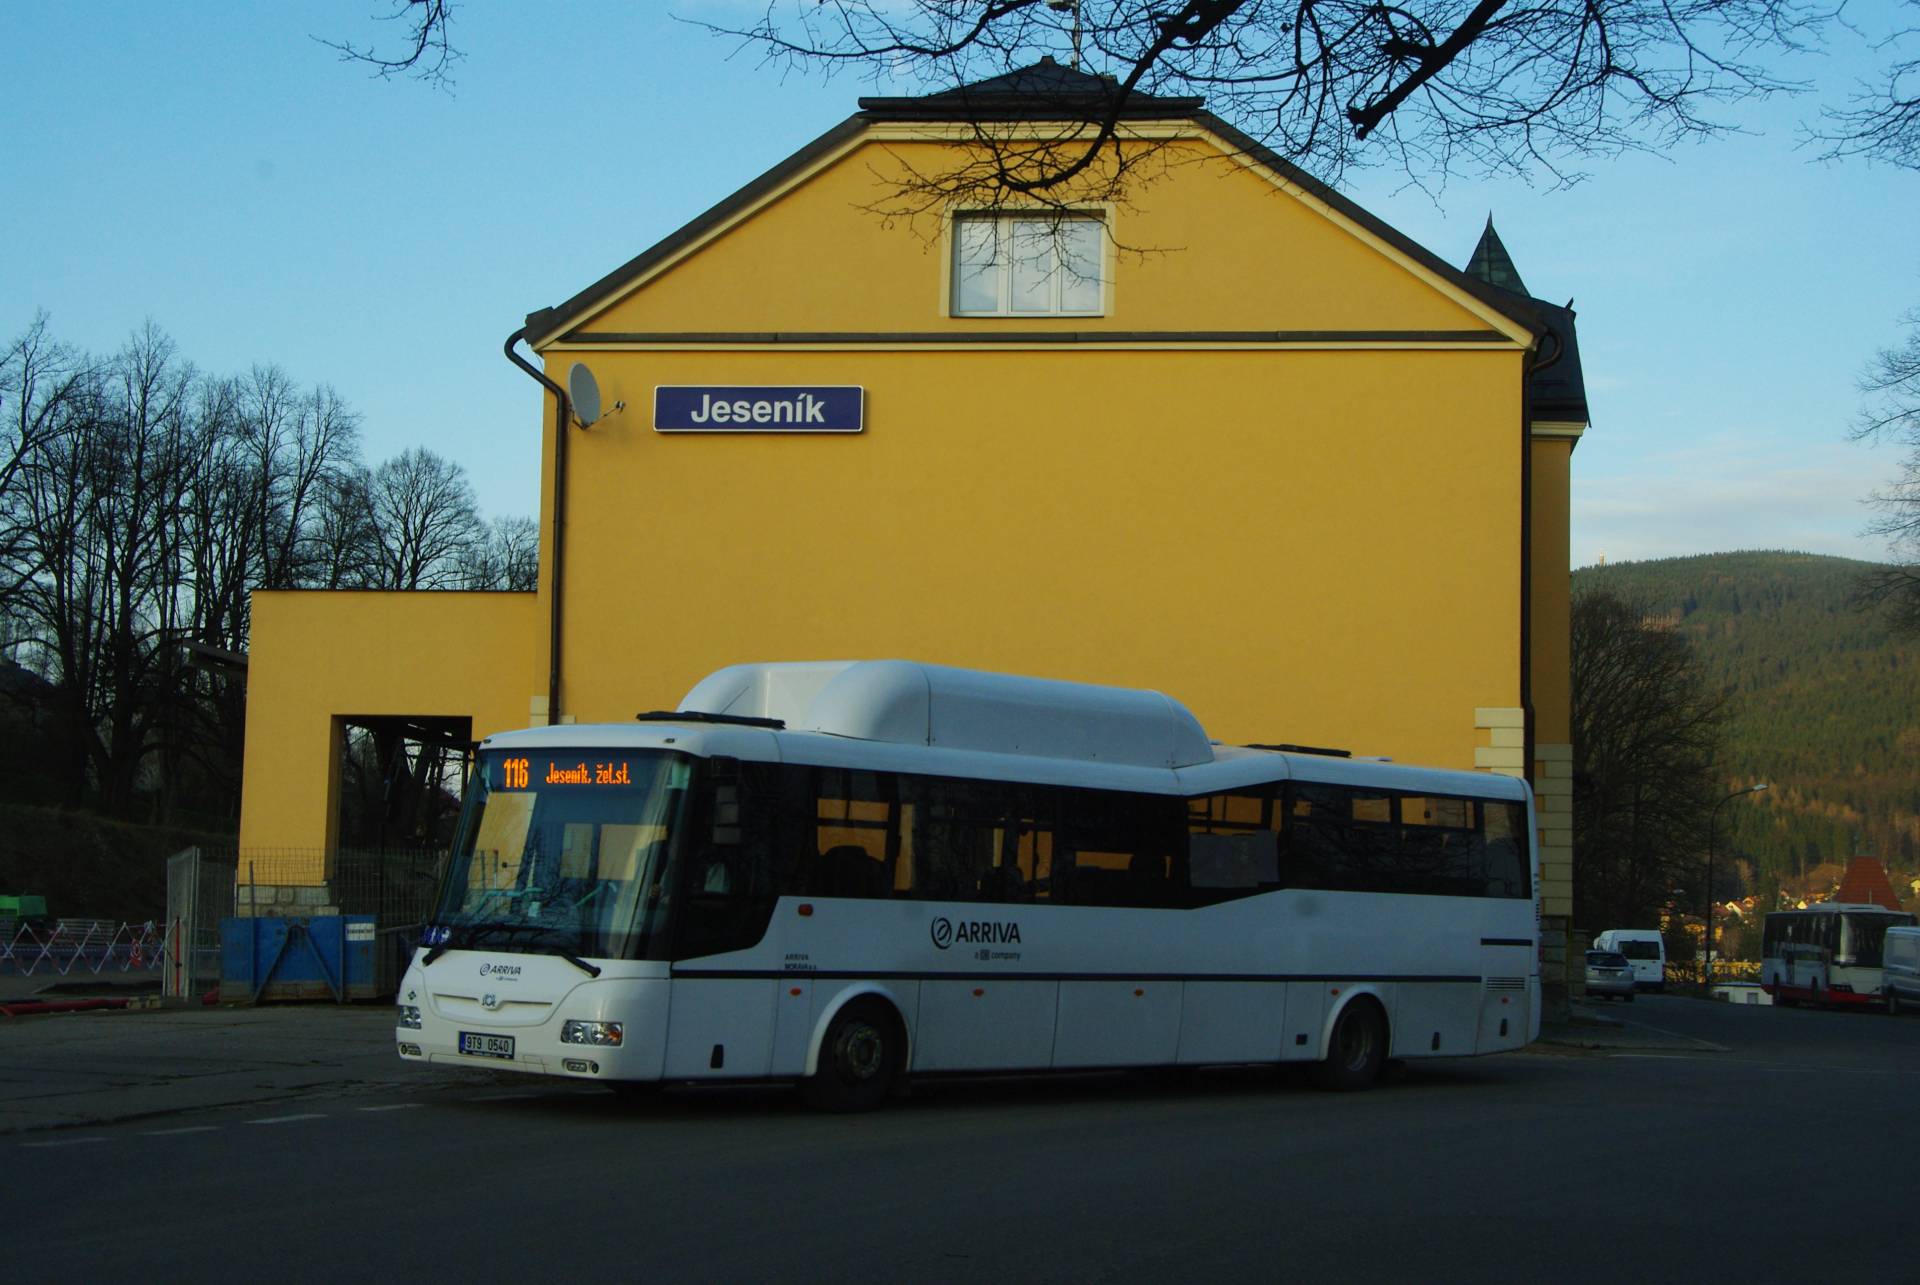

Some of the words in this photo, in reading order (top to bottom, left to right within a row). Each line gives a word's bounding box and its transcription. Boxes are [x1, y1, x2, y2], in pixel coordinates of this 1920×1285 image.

[691, 393, 825, 423] Jeseník
[503, 758, 529, 788] 116
[596, 763, 631, 784] žel.st.
[955, 922, 1021, 943] ARRIVA
[489, 965, 521, 975] ARRIVA
[466, 1036, 482, 1049] 9T9
[487, 1038, 509, 1052] 0540
